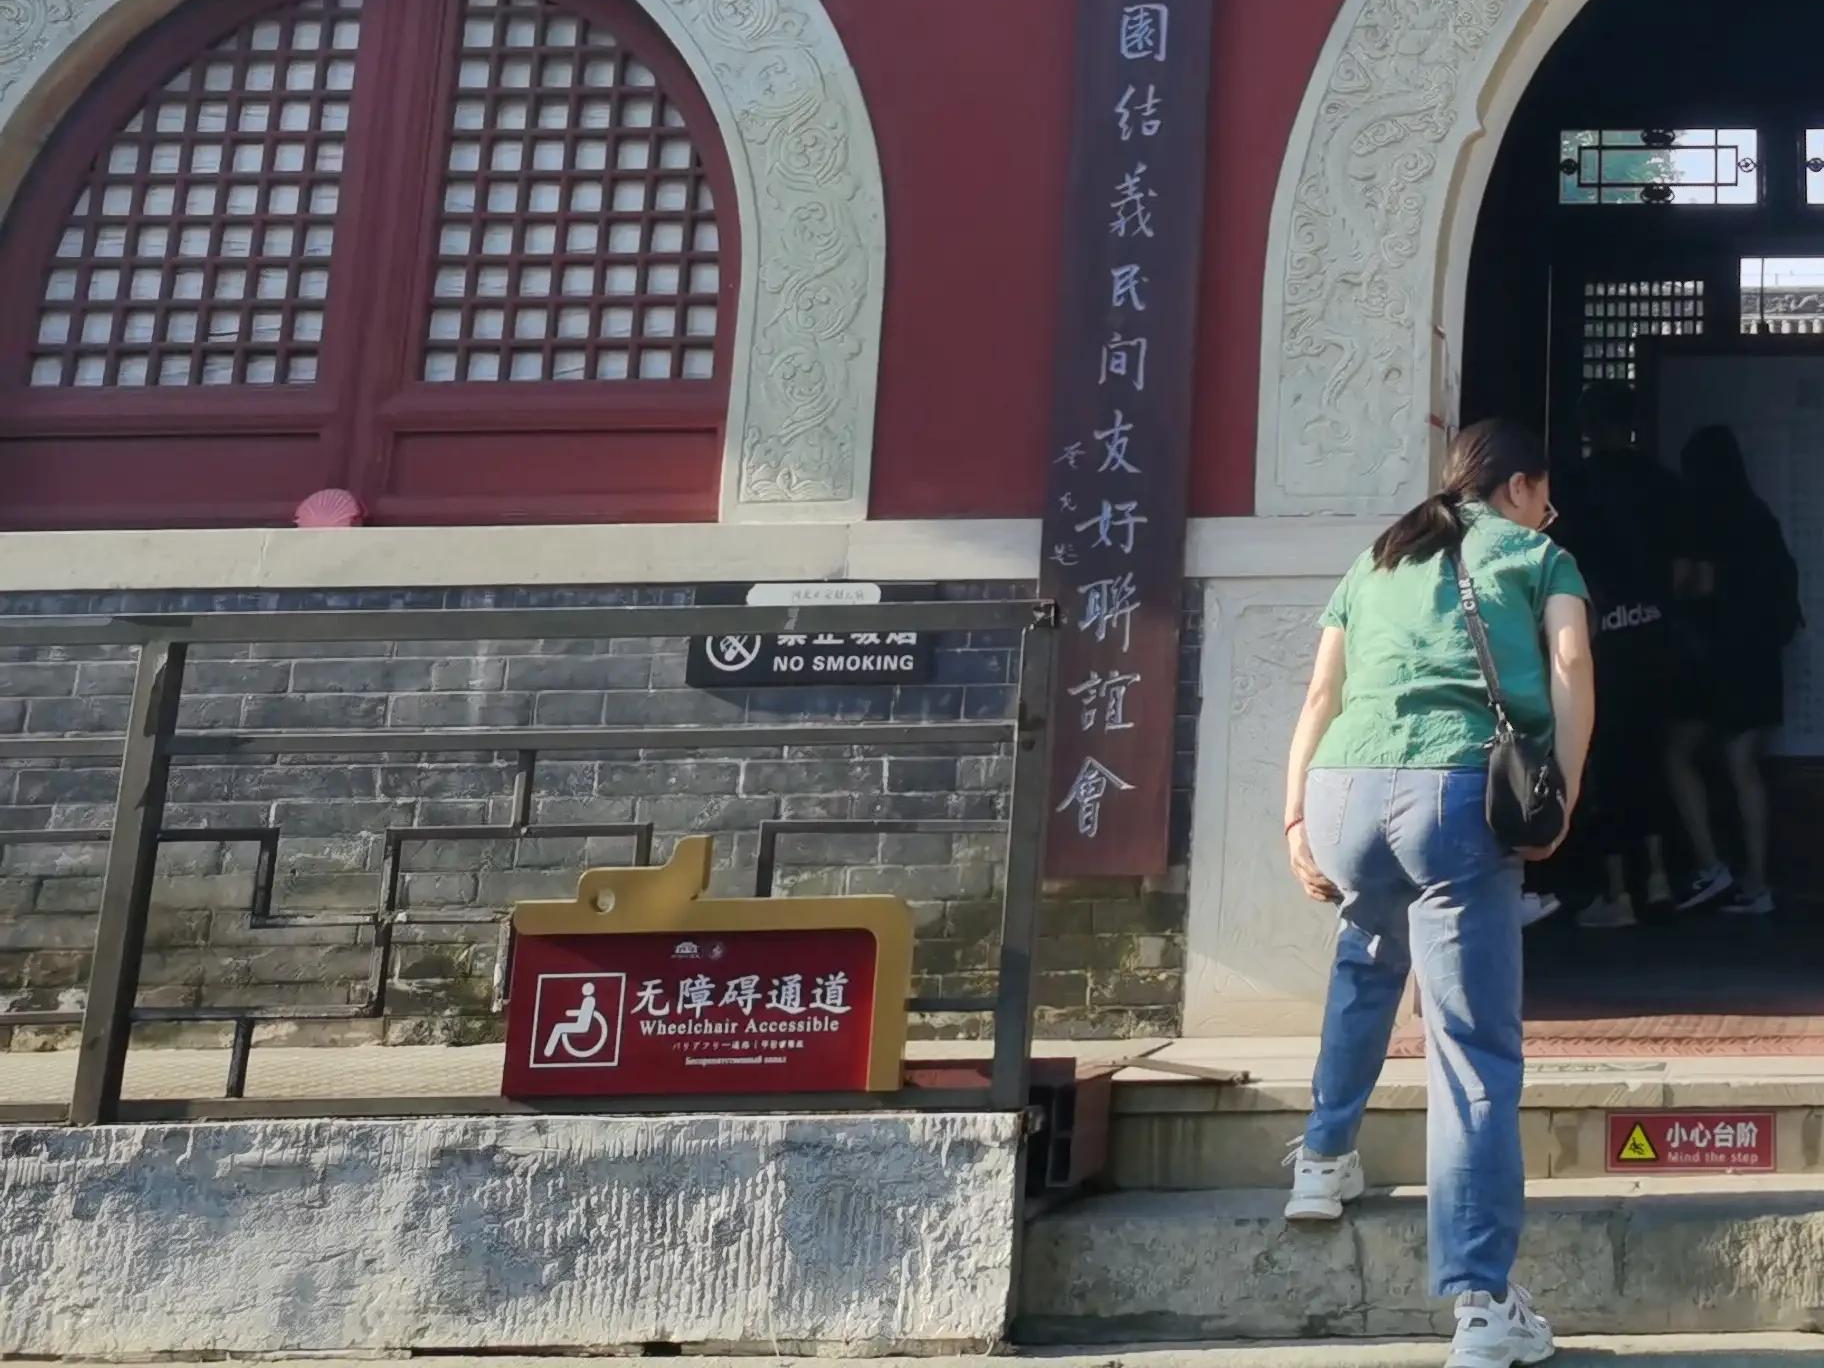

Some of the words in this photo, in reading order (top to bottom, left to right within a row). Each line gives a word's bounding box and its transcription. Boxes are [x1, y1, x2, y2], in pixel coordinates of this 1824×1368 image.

[773, 655, 804, 672] NO
[812, 654, 914, 671] SMOKING
[631, 971, 852, 1018] 无障碍通道
[640, 1018, 738, 1036] Wheelchair
[746, 1016, 839, 1033] Accessible
[1666, 1121, 1758, 1148] 小心台阶
[1668, 1152, 1700, 1162] Mind
[1705, 1151, 1726, 1162] the
[1730, 1152, 1759, 1164] step
